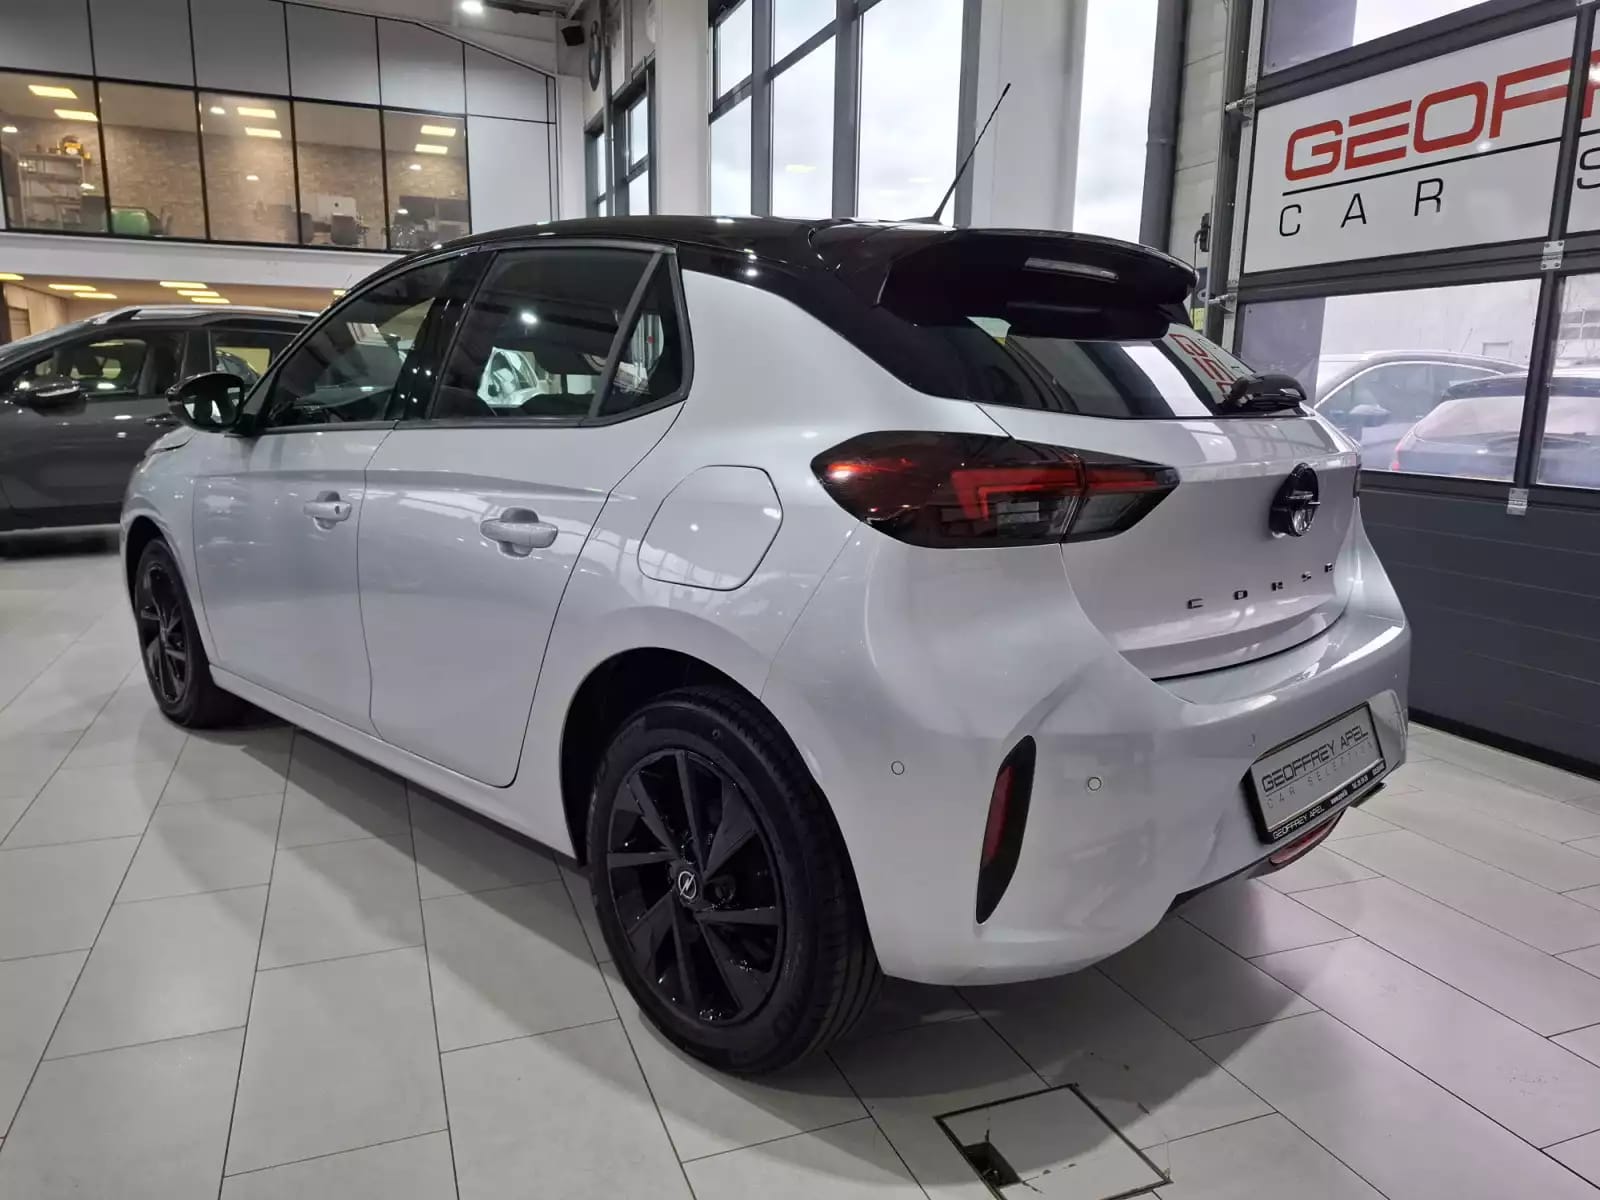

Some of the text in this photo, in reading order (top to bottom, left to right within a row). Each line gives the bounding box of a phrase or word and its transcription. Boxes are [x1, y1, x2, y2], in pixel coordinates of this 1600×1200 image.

[1279, 178, 1444, 237] CAR
[1261, 725, 1369, 793] GEOFFREY APEL
